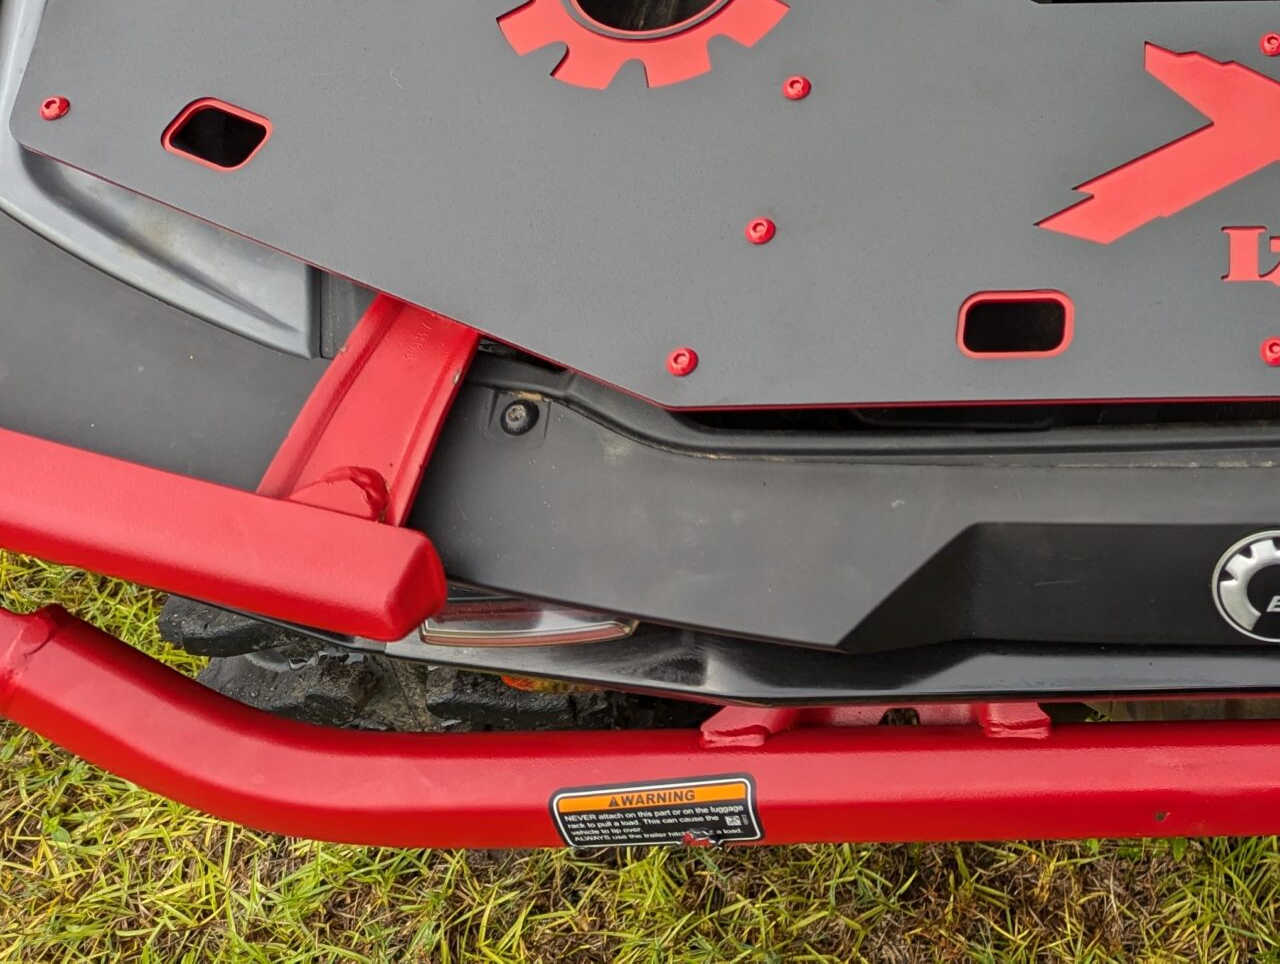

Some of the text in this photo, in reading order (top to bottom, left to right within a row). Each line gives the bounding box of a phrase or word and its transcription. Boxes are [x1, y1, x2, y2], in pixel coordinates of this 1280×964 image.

[620, 789, 696, 806] WARNING
[564, 813, 597, 822] NEVER
[598, 812, 624, 820] attach
[654, 809, 672, 817] part
[695, 806, 709, 814] the
[710, 805, 744, 814] luggage
[567, 821, 586, 829] rack
[597, 820, 612, 829] pull
[571, 828, 600, 836] vehicle
[610, 827, 622, 835] tip
[574, 834, 611, 842] ALWAYS
[643, 831, 667, 839] trailer
